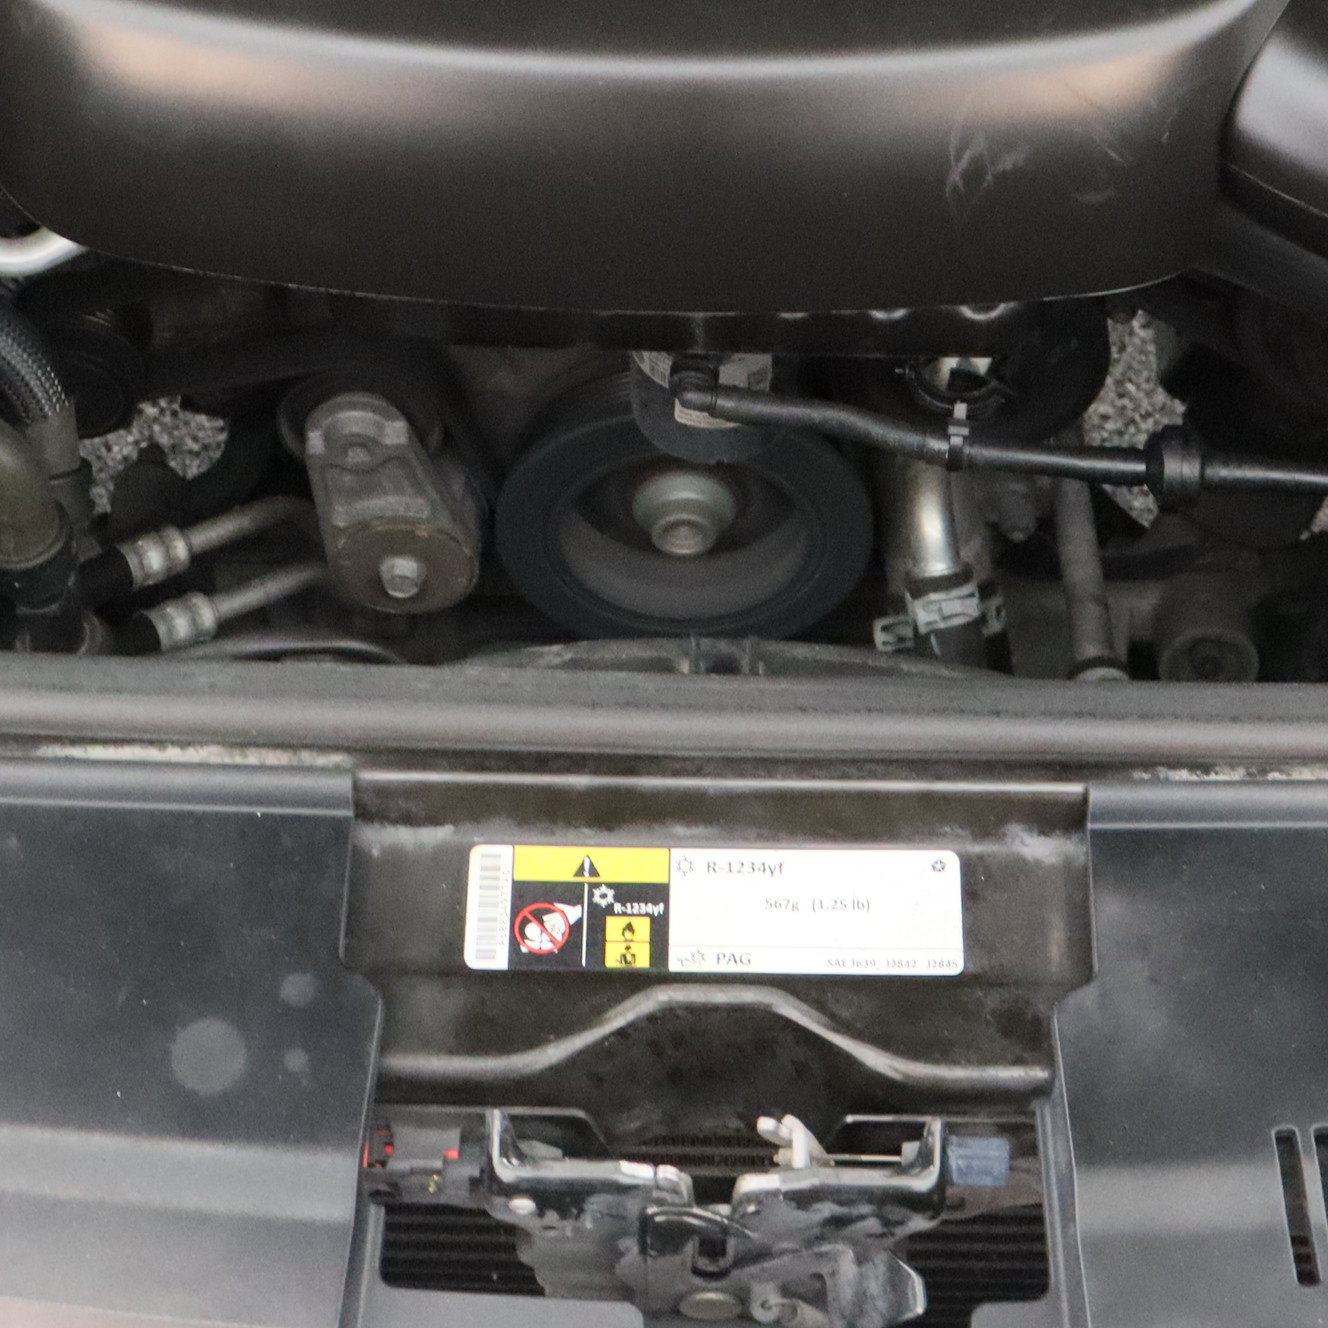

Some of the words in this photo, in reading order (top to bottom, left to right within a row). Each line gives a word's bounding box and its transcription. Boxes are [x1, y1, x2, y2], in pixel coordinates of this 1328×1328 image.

[706, 860, 784, 877] R-1234yf
[613, 902, 665, 917] R-1234yf
[765, 897, 799, 912] 567g
[811, 898, 848, 913] (1.25
[852, 897, 871, 913] lb)
[716, 952, 752, 965] PAG
